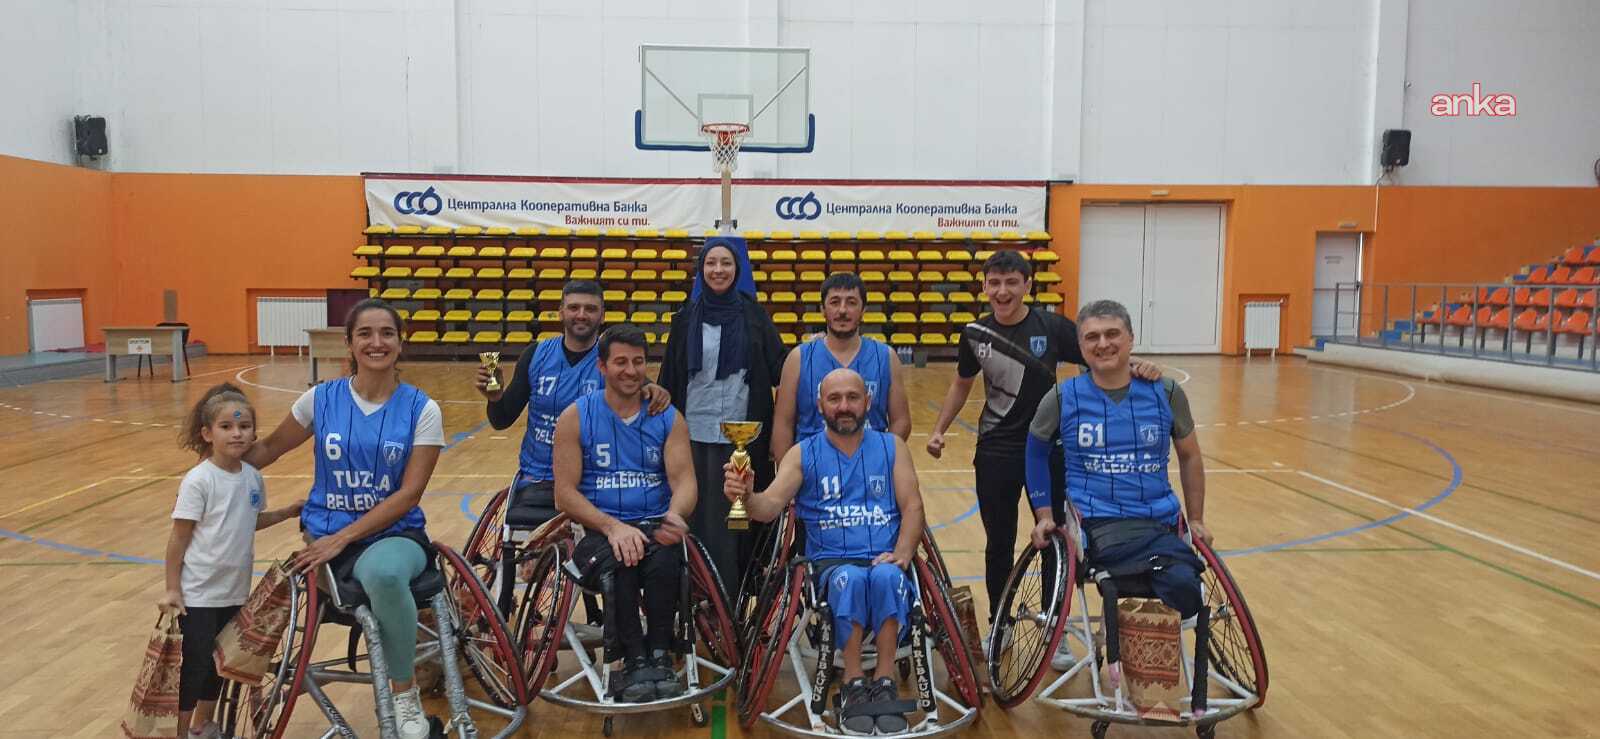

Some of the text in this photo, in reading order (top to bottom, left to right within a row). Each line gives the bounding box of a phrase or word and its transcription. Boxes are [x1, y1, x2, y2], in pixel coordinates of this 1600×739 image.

[447, 198, 648, 214] Централна Кооперативна Банка
[826, 202, 1018, 217] Централна Кооперативна Банка
[565, 214, 615, 226] Важният
[617, 217, 629, 226] си
[937, 216, 986, 228] Важният
[988, 218, 999, 228] си
[978, 341, 993, 359] 61
[537, 375, 557, 397] 17
[1077, 422, 1106, 448] 61
[325, 432, 342, 461] 6
[595, 443, 611, 468] 5
[821, 475, 841, 500] 11
[824, 504, 884, 519] TUZLA
